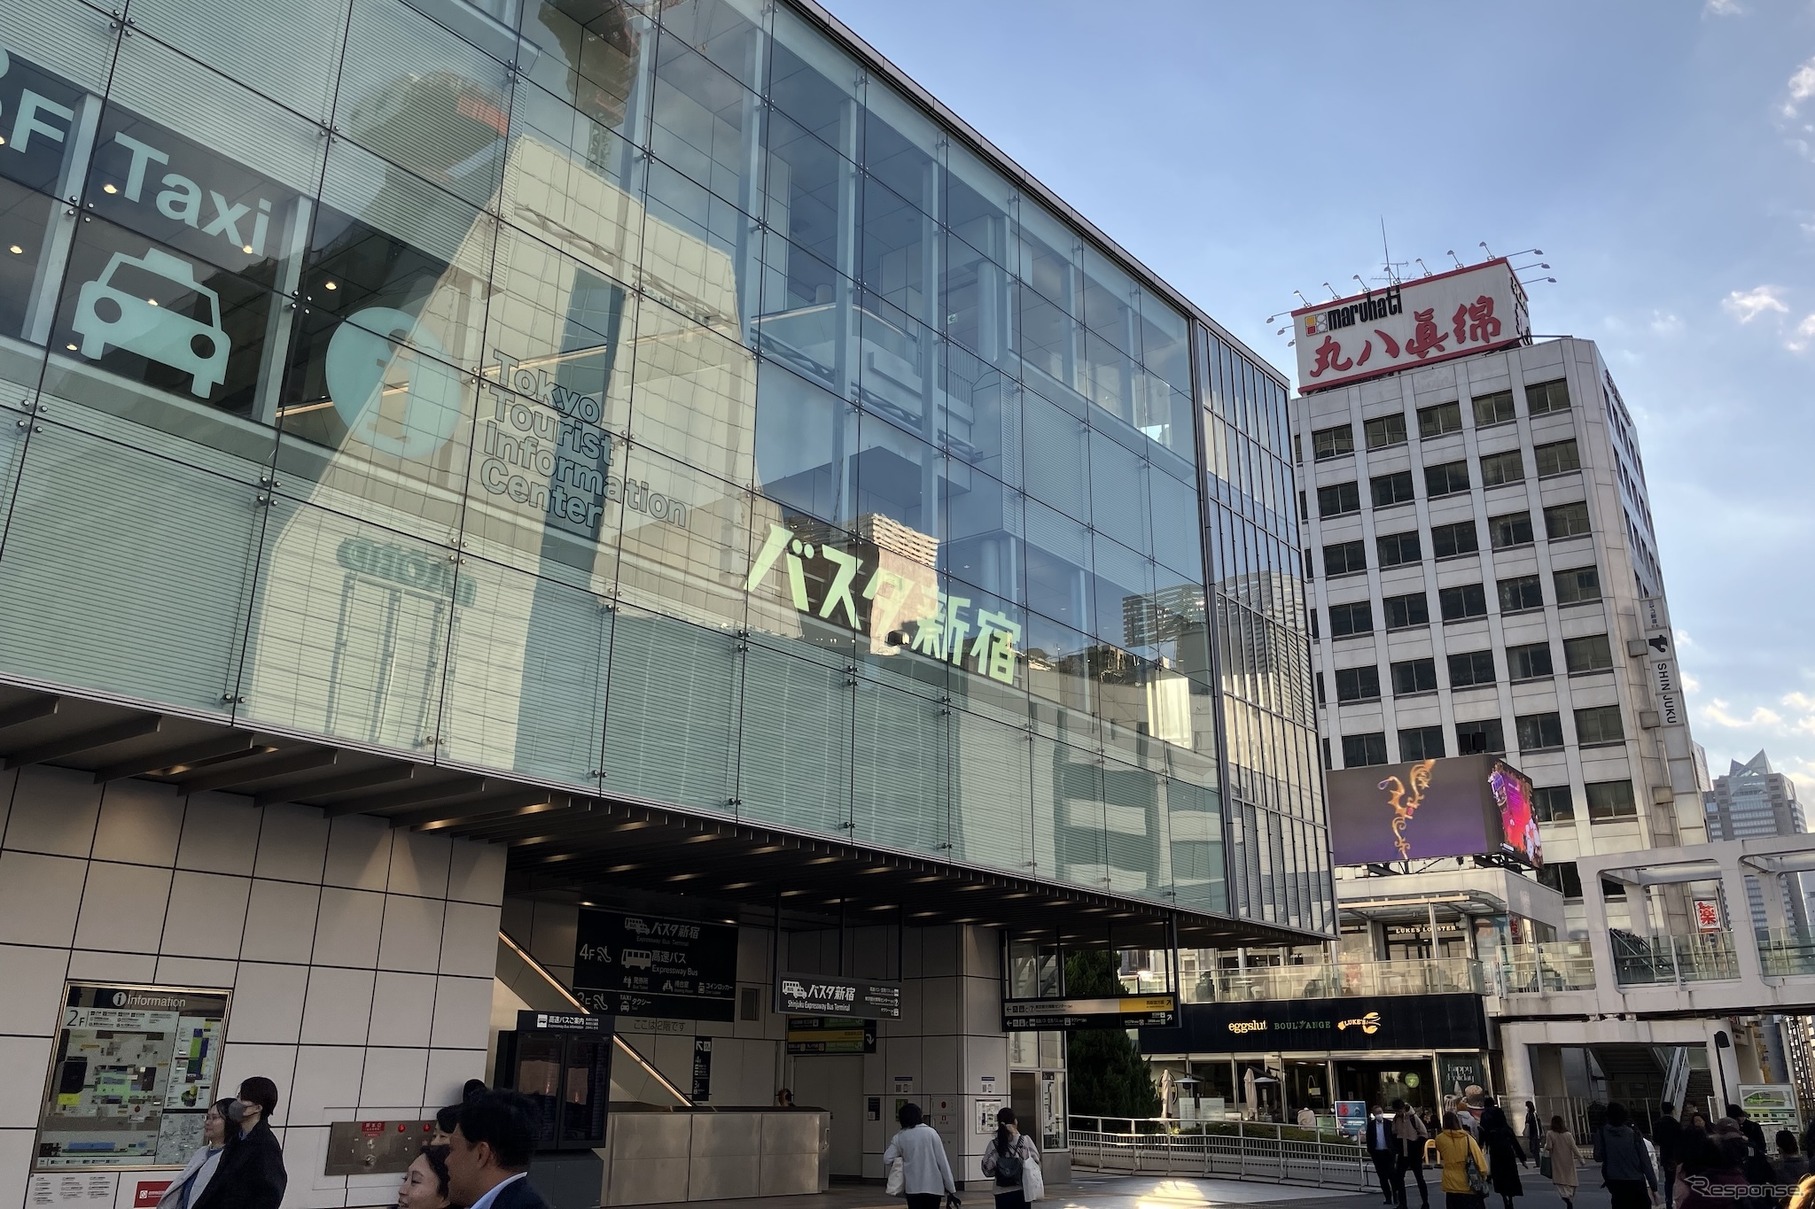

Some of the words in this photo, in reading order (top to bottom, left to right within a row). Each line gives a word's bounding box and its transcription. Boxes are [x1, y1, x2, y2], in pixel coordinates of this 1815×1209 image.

[0, 47, 75, 153] F
[114, 131, 272, 257] Taxi
[1327, 284, 1403, 331] maruhati
[492, 349, 600, 425] Tokyo
[489, 385, 616, 467] Tourist
[484, 421, 687, 528] Information
[480, 459, 603, 529] Center
[743, 523, 1022, 685] バスタ新宿
[650, 922, 701, 940] バスタ新宿
[1422, 925, 1457, 933] LOSTER
[579, 943, 596, 961] 4F
[651, 950, 687, 964] 高速バス
[651, 964, 687, 977] Expressway
[687, 967, 698, 977] Bus
[127, 996, 186, 1008] Information
[808, 984, 856, 1002] バスタ新宿
[67, 1010, 85, 1027] 2F
[1228, 1019, 1268, 1034] eggslut
